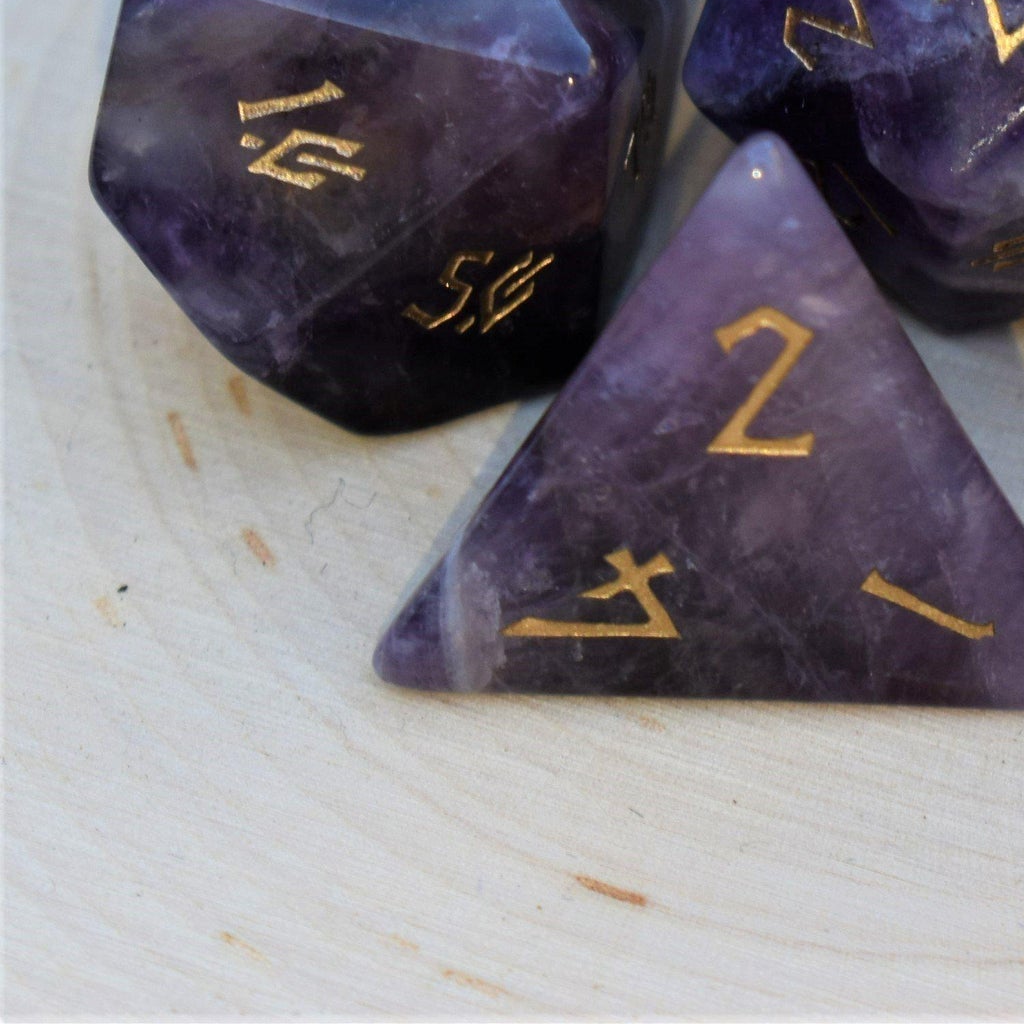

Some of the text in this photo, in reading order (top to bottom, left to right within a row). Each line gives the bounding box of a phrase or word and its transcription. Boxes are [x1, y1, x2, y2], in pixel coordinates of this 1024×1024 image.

[706, 306, 815, 457] 2
[500, 547, 682, 639] 4
[860, 568, 996, 640] 1
